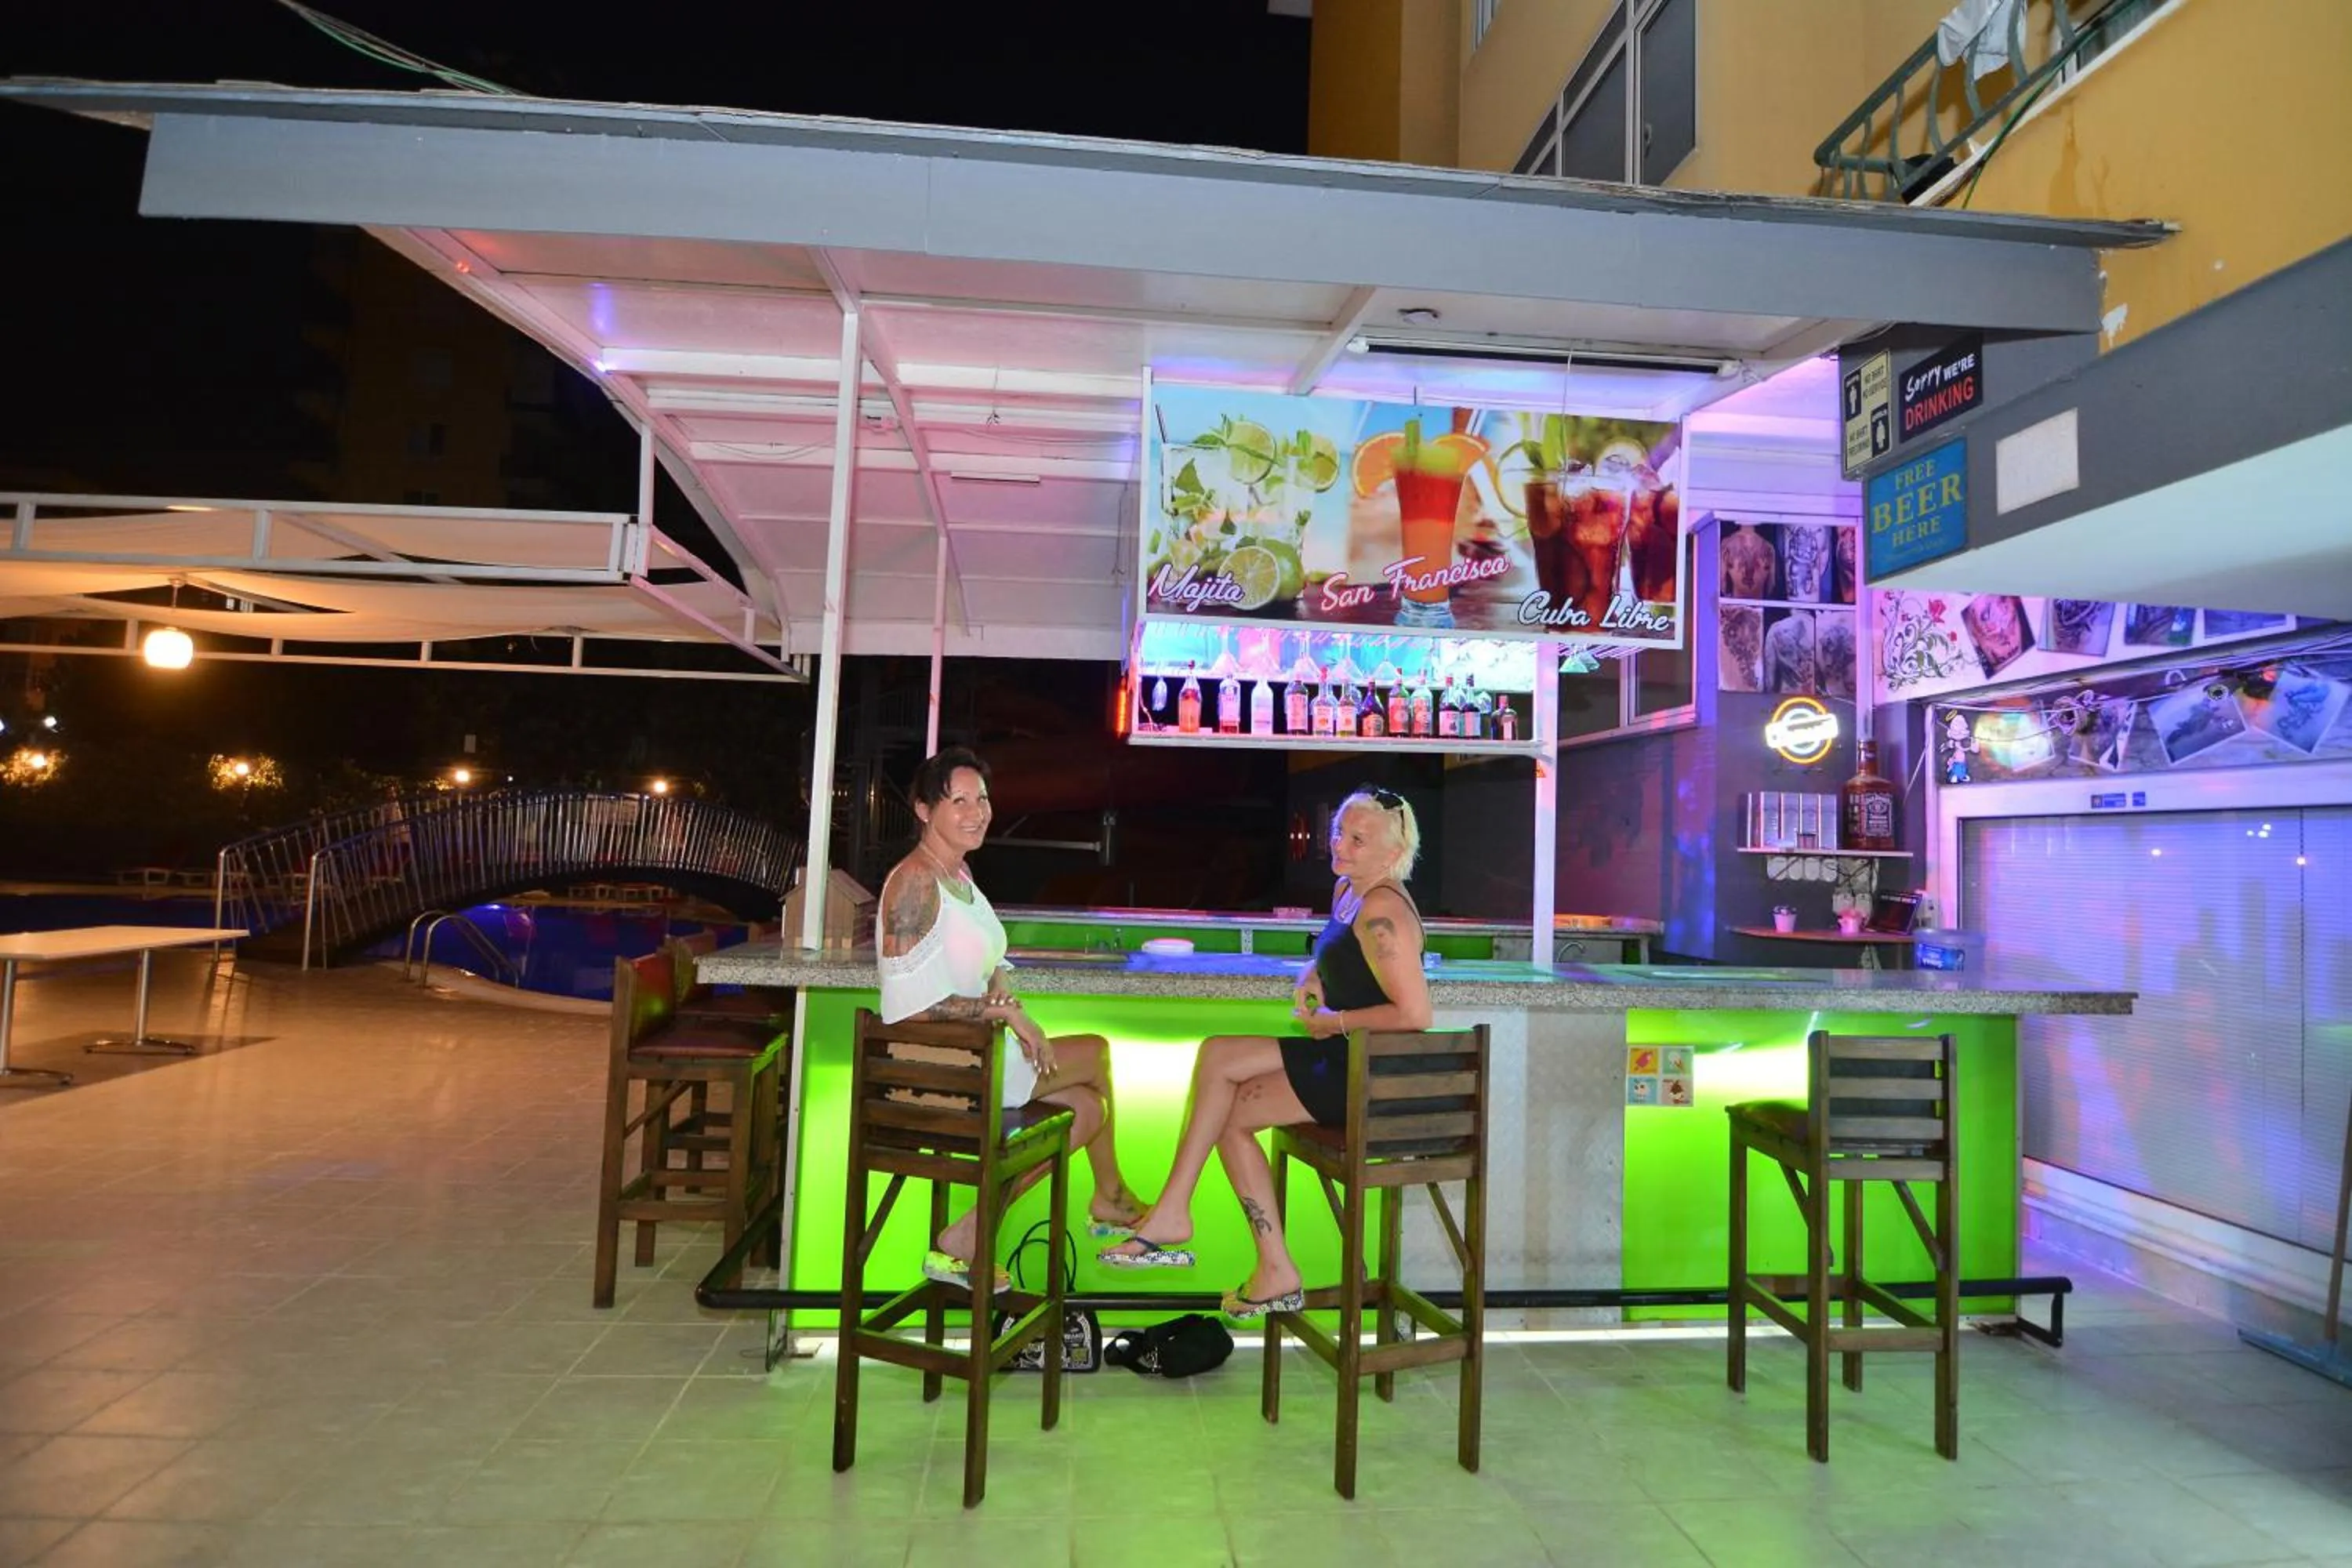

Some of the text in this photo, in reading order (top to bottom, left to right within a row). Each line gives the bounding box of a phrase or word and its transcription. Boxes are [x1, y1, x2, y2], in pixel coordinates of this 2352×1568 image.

[1943, 354, 1975, 381] WE'RE
[1905, 376, 1973, 430] DRINKING
[1896, 459, 1936, 490] FREE
[1872, 474, 1963, 534] BEER
[1893, 515, 1942, 548] HERE
[1321, 557, 1509, 611] San Francisco
[1518, 590, 1669, 631] Cuba Libre
